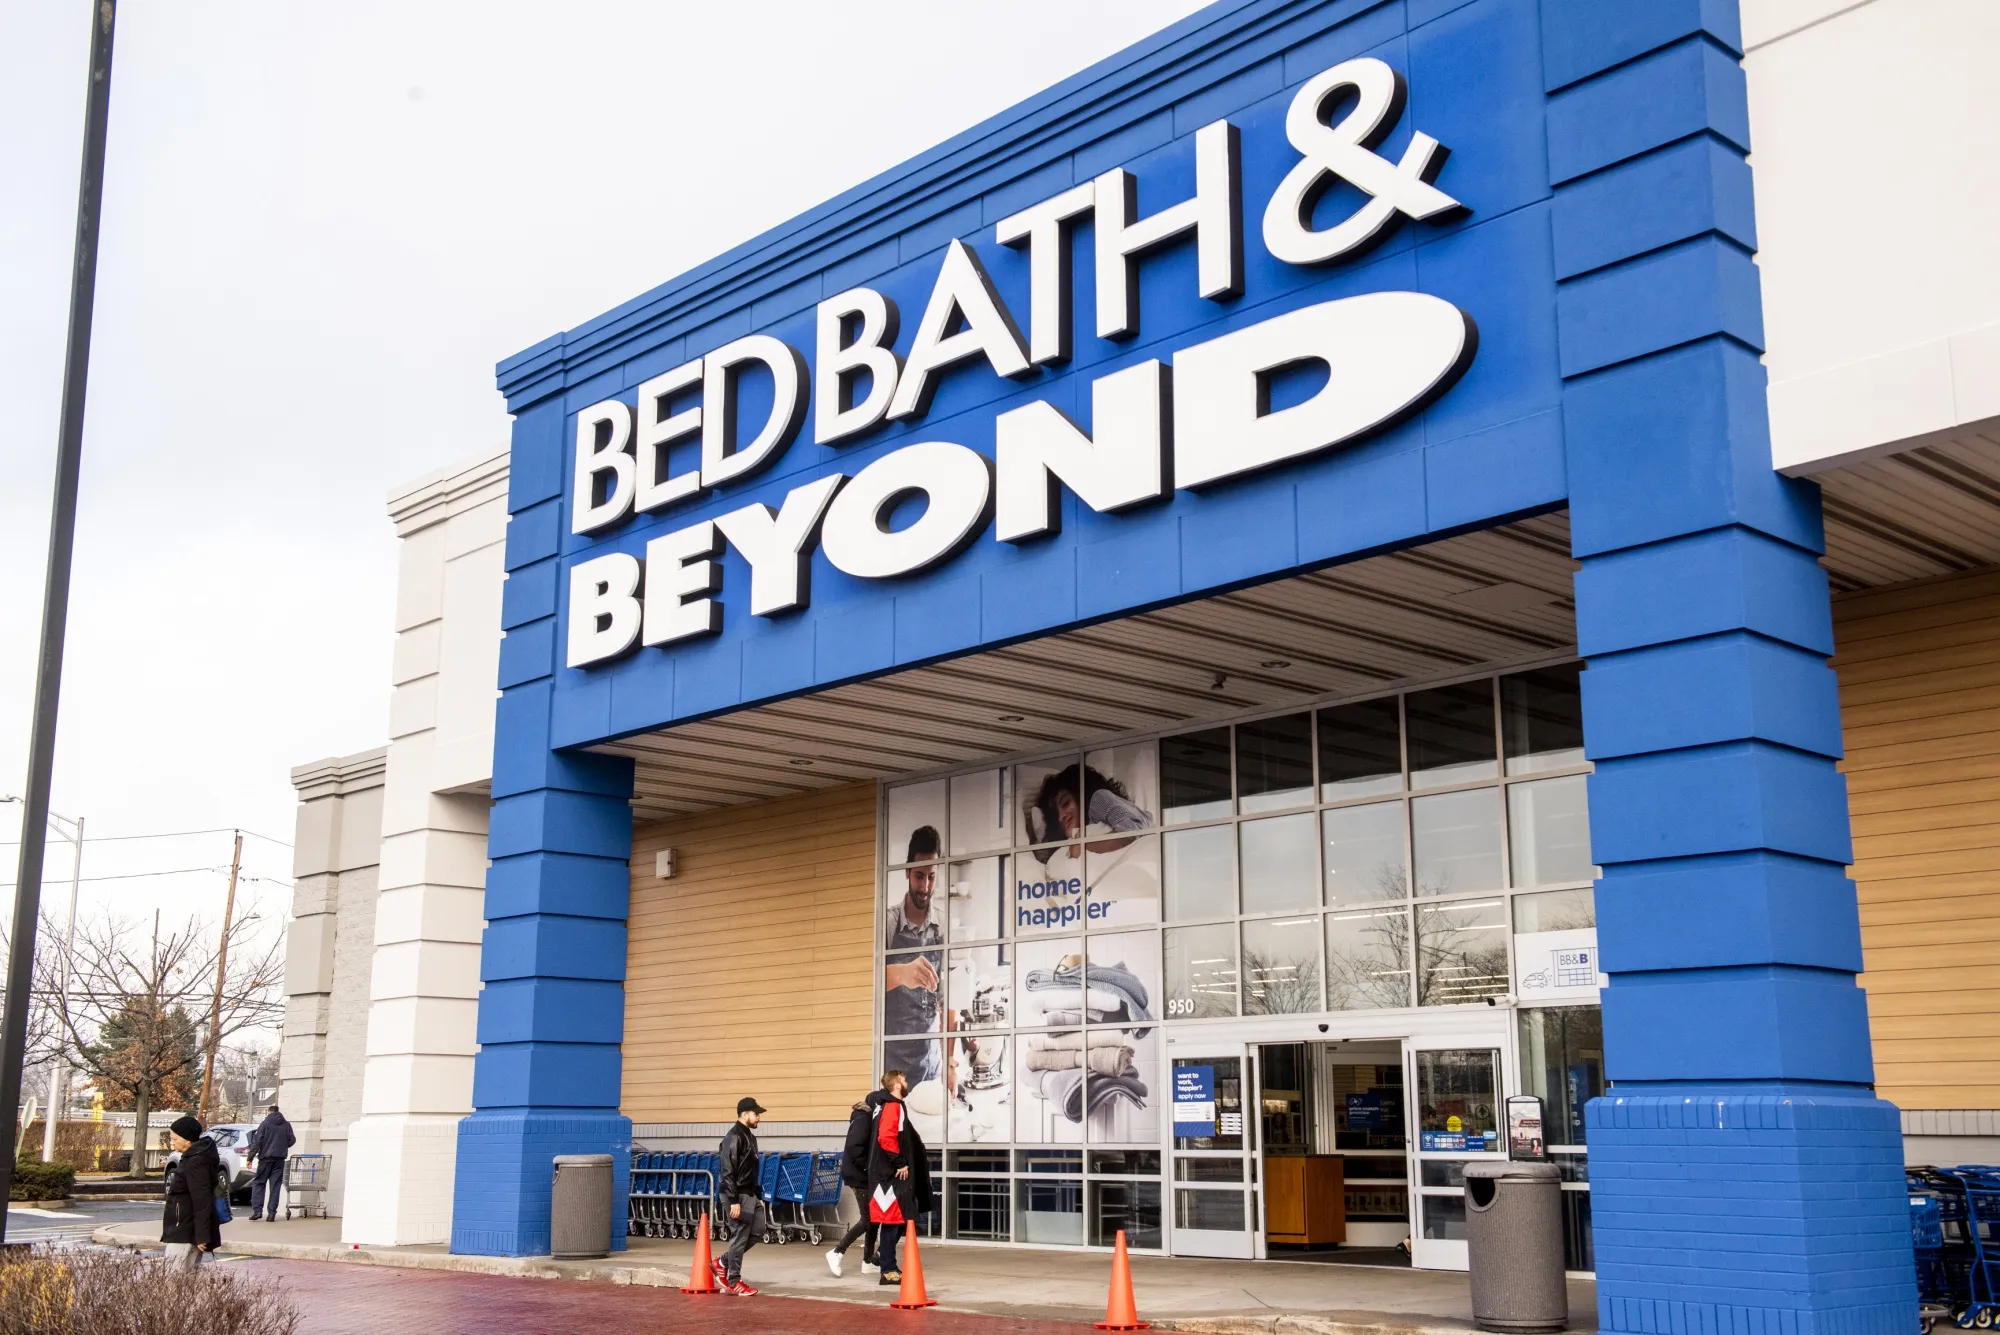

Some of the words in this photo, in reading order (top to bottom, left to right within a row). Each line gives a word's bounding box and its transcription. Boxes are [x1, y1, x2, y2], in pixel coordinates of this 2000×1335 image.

[571, 334, 809, 537] BED
[814, 118, 1246, 447] BATH
[1262, 57, 1472, 267] &
[567, 290, 1479, 670] BEYOND
[1168, 998, 1195, 1014] 950
[1559, 953, 1589, 966] BB&B
